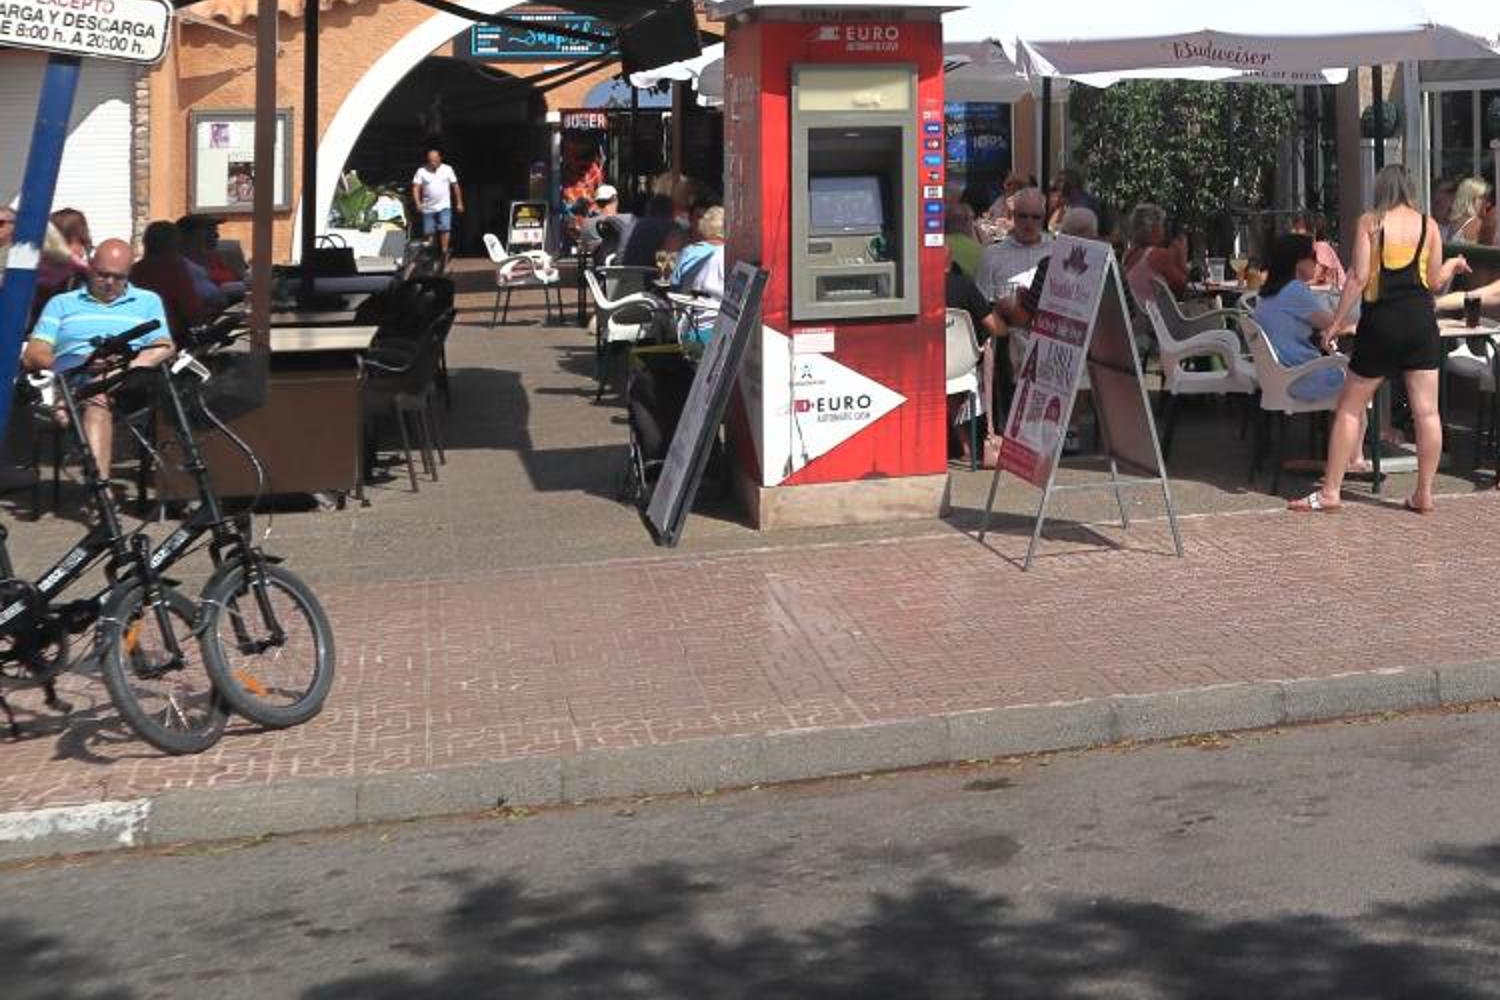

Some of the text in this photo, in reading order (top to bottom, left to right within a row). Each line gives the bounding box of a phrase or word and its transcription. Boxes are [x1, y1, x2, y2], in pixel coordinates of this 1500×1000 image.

[49, 11, 60, 24] Y
[63, 13, 156, 39] DESCARGA
[846, 26, 899, 41] EURO
[16, 23, 49, 39] 8:00
[53, 28, 67, 43] h.
[70, 32, 82, 45] A
[86, 34, 128, 51] 20:00
[132, 39, 146, 55] h.
[1171, 40, 1273, 65] Budweiser
[817, 394, 872, 413] EURO
